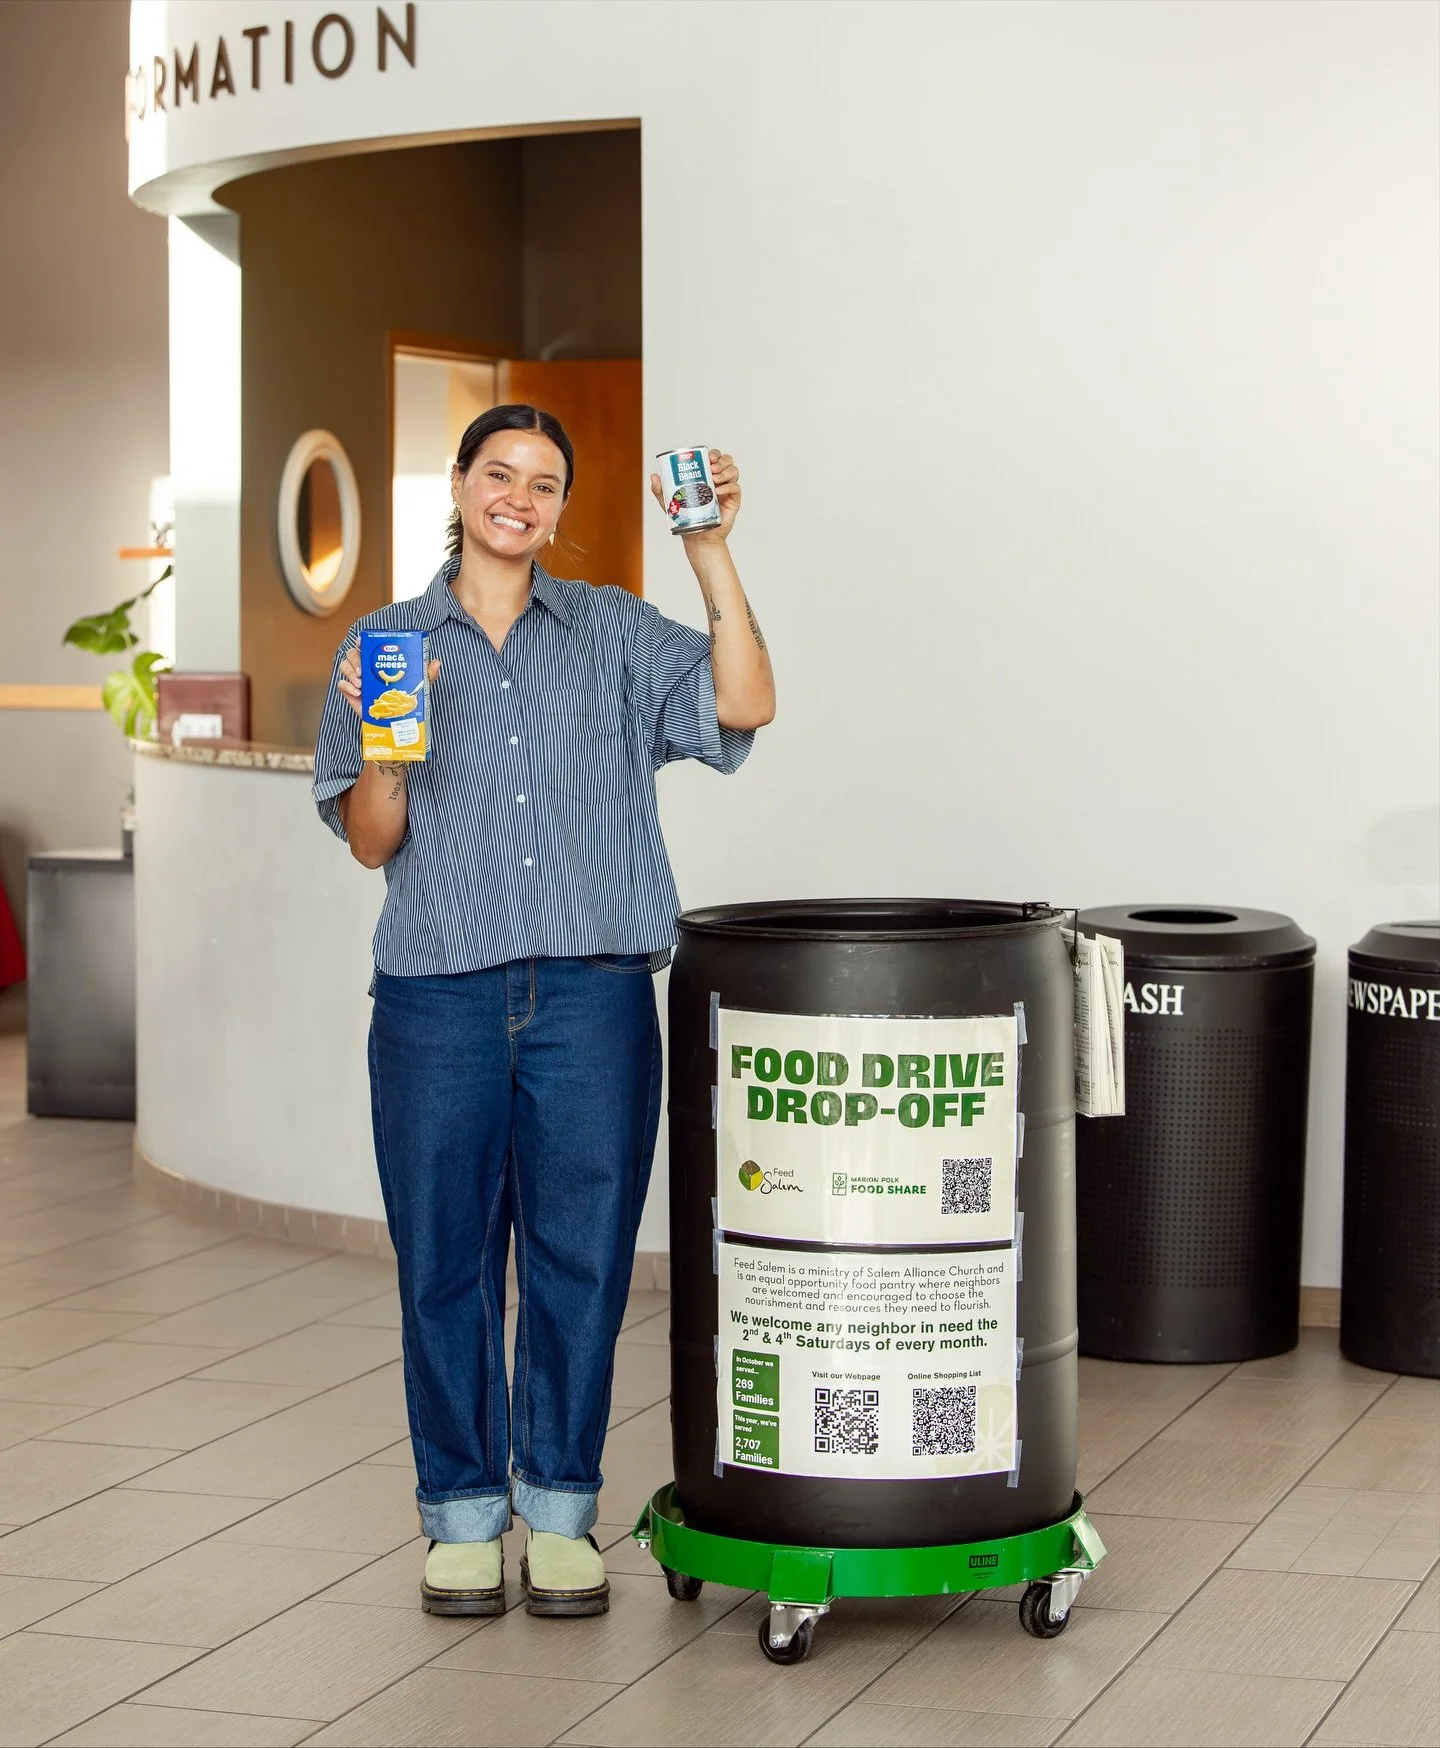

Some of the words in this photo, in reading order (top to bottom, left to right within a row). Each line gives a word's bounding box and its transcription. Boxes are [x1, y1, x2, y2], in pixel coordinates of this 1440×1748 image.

[677, 460, 699, 472] Black
[678, 470, 702, 481] Beans
[731, 1044, 849, 1086] FOOD
[862, 1052, 1004, 1088] DRIVE
[747, 1085, 986, 1127] DROP-OFF
[773, 1168, 794, 1177] Feed
[760, 1171, 803, 1195] Salem
[851, 1185, 884, 1194] FOOD
[887, 1185, 927, 1194] SHARE
[734, 1257, 755, 1270] Feed
[757, 1261, 786, 1273] Salem
[788, 1265, 796, 1274] is
[808, 1266, 850, 1279] ministry
[852, 1267, 864, 1278] of
[867, 1267, 900, 1278] Salem
[903, 1267, 946, 1277] Alliance
[948, 1264, 985, 1276] Church
[987, 1262, 1004, 1274] and
[737, 1270, 744, 1280] is
[745, 1273, 756, 1282] an
[758, 1274, 785, 1286] equal
[787, 1278, 849, 1291] opportunity
[851, 1279, 877, 1289] food
[880, 1280, 915, 1292] pantry
[918, 1278, 951, 1289] where
[953, 1276, 1000, 1289] neighbors
[752, 1286, 767, 1295] are
[770, 1287, 820, 1299] welcomed
[823, 1289, 844, 1300] and
[847, 1290, 912, 1303] encouraged
[915, 1291, 926, 1301] to
[929, 1290, 965, 1300] choose
[968, 1287, 984, 1298] the
[745, 1296, 803, 1310] nourishment
[805, 1301, 825, 1311] and
[828, 1304, 881, 1313] resources
[884, 1303, 908, 1315] they
[911, 1302, 937, 1312] need
[940, 1302, 951, 1311] to
[954, 1299, 992, 1310] flourish.
[730, 1310, 748, 1324] We
[752, 1316, 812, 1331] welcome
[817, 1322, 842, 1335] any
[848, 1322, 916, 1337] neighbor
[920, 1321, 934, 1333] in
[939, 1319, 973, 1333] need
[977, 1318, 998, 1330] the
[762, 1331, 772, 1344] &
[796, 1335, 870, 1352] Saturdays
[875, 1338, 891, 1350] of
[895, 1340, 935, 1352] every
[940, 1335, 987, 1349] month.
[742, 1357, 764, 1366] October
[812, 1371, 829, 1379] Visit
[844, 1372, 881, 1381] Webpage
[907, 1372, 932, 1380] Online
[933, 1371, 968, 1380] Shopping
[735, 1378, 754, 1390] 269
[736, 1391, 774, 1406] Families
[735, 1414, 745, 1422] This
[746, 1418, 760, 1426] year,
[735, 1424, 752, 1433] served
[735, 1436, 761, 1450] 2,707
[735, 1450, 773, 1465] Families
[970, 1556, 997, 1566] ULINE
